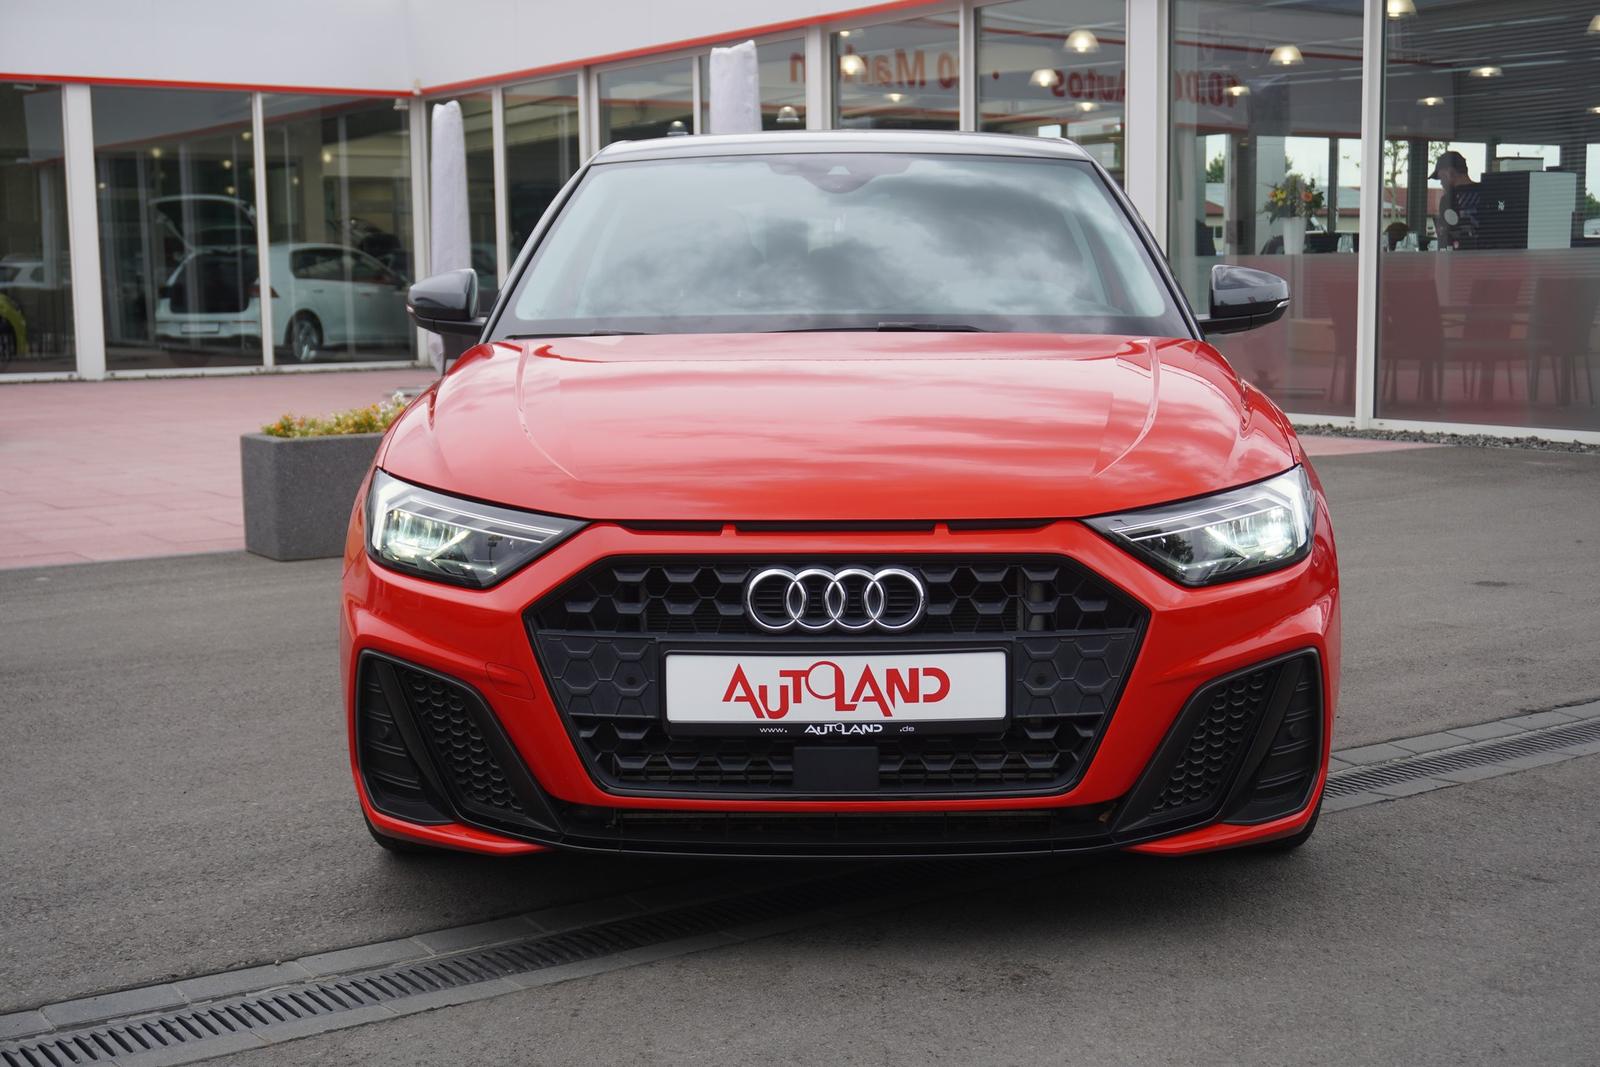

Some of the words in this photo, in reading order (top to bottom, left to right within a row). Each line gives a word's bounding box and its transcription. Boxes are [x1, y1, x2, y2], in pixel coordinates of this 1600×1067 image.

[722, 660, 951, 720] AUTOLAND
[759, 726, 788, 734] www.
[899, 725, 915, 733] .de
